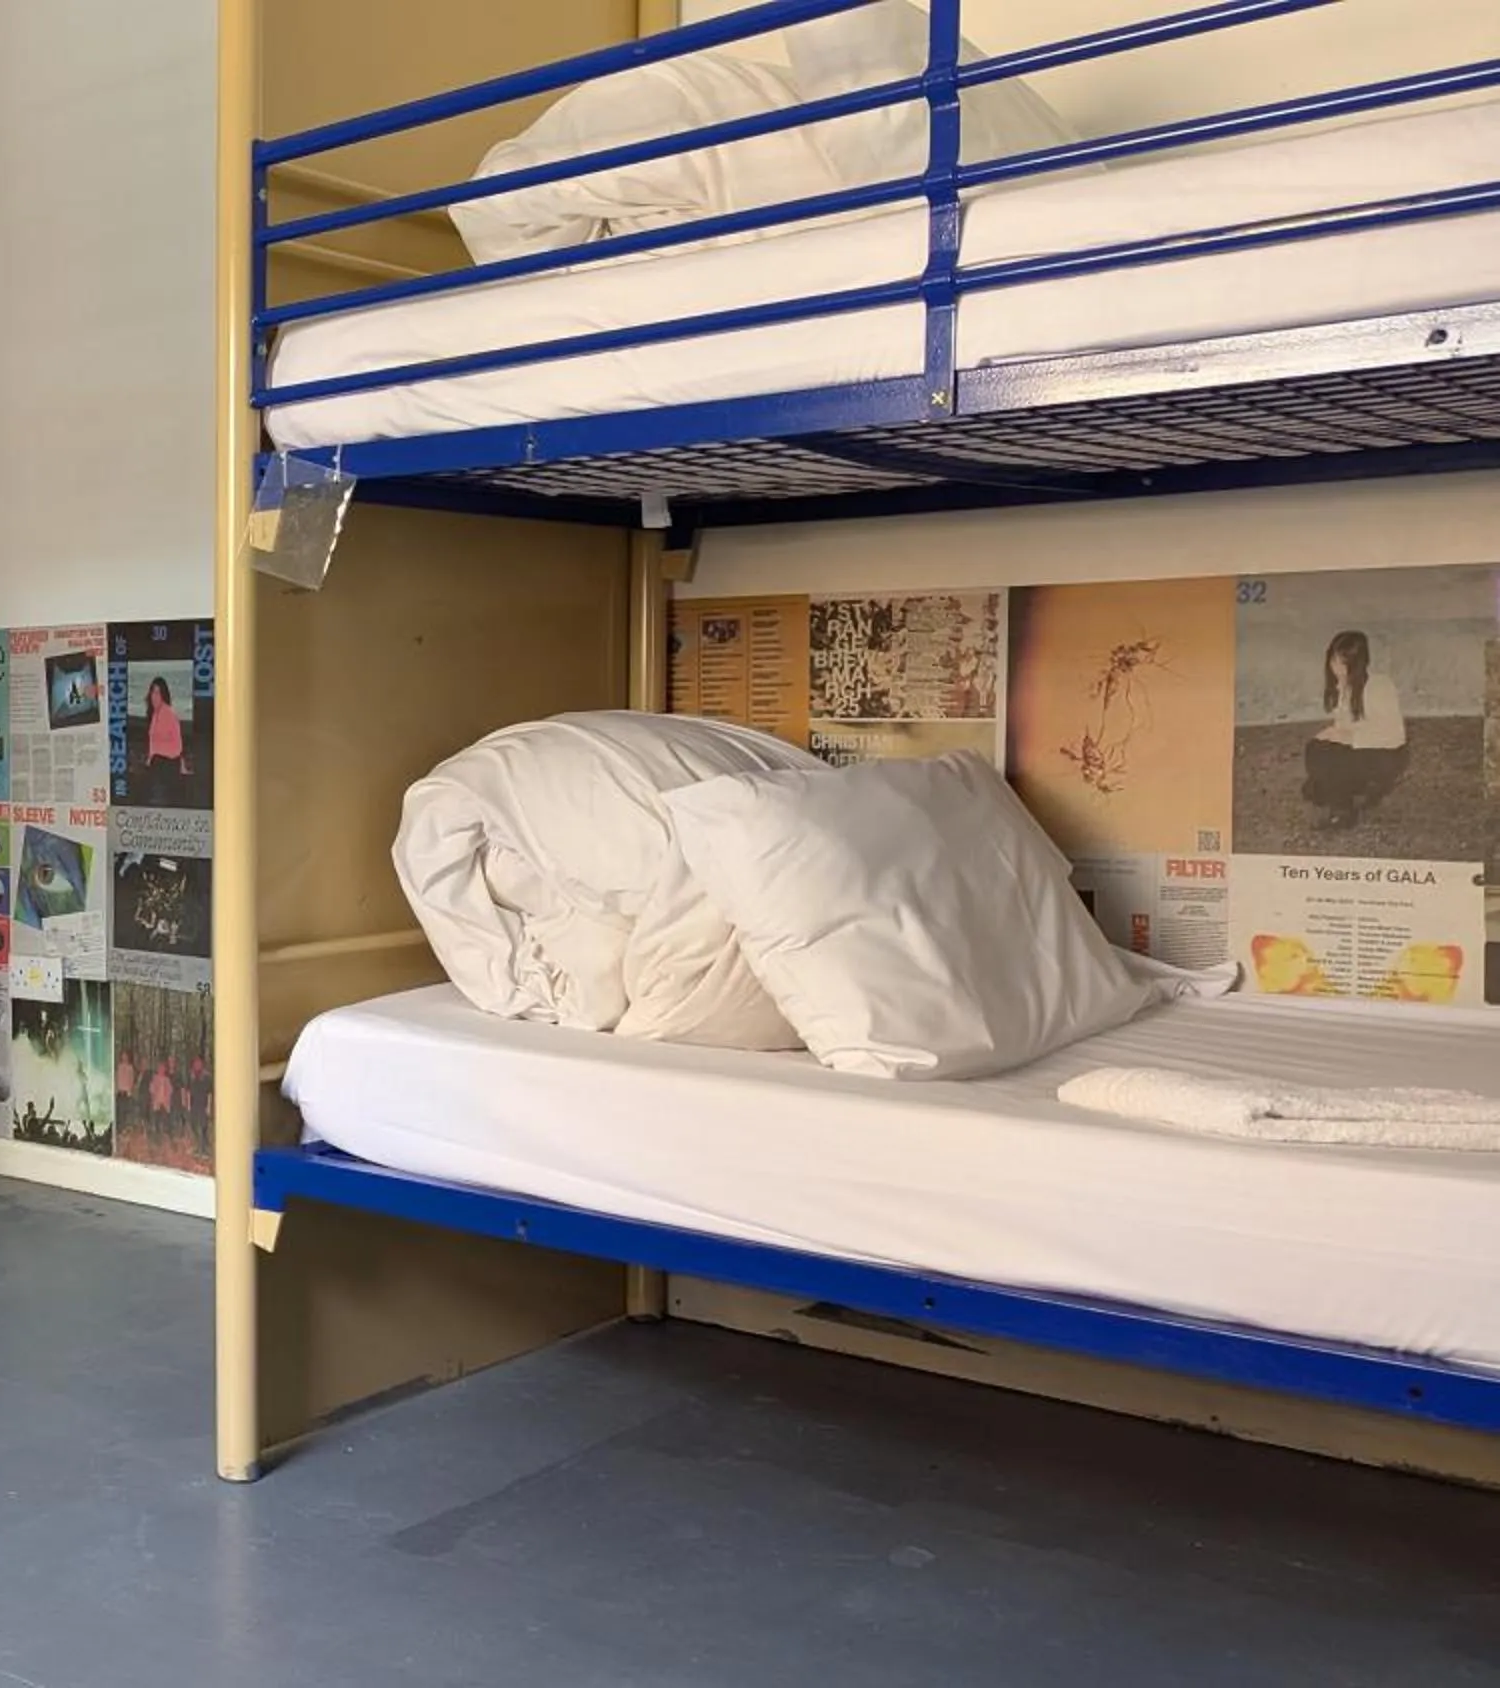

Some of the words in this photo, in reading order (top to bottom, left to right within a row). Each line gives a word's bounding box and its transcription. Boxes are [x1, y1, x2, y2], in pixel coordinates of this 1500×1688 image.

[1235, 580, 1267, 605] 32
[827, 619, 873, 637] RAN
[114, 634, 127, 655] OF
[193, 624, 214, 697] LOST
[832, 667, 866, 683] MA
[825, 681, 872, 700] RCH
[109, 661, 127, 773] SEARCH
[835, 698, 860, 716] 25
[12, 805, 56, 824] SLEEVE
[69, 808, 107, 827] NOTES
[1165, 859, 1226, 878] FILTER
[1279, 865, 1310, 880] Ten
[1314, 866, 1361, 881] Years
[1364, 869, 1382, 882] of
[1386, 869, 1437, 885] GALA
